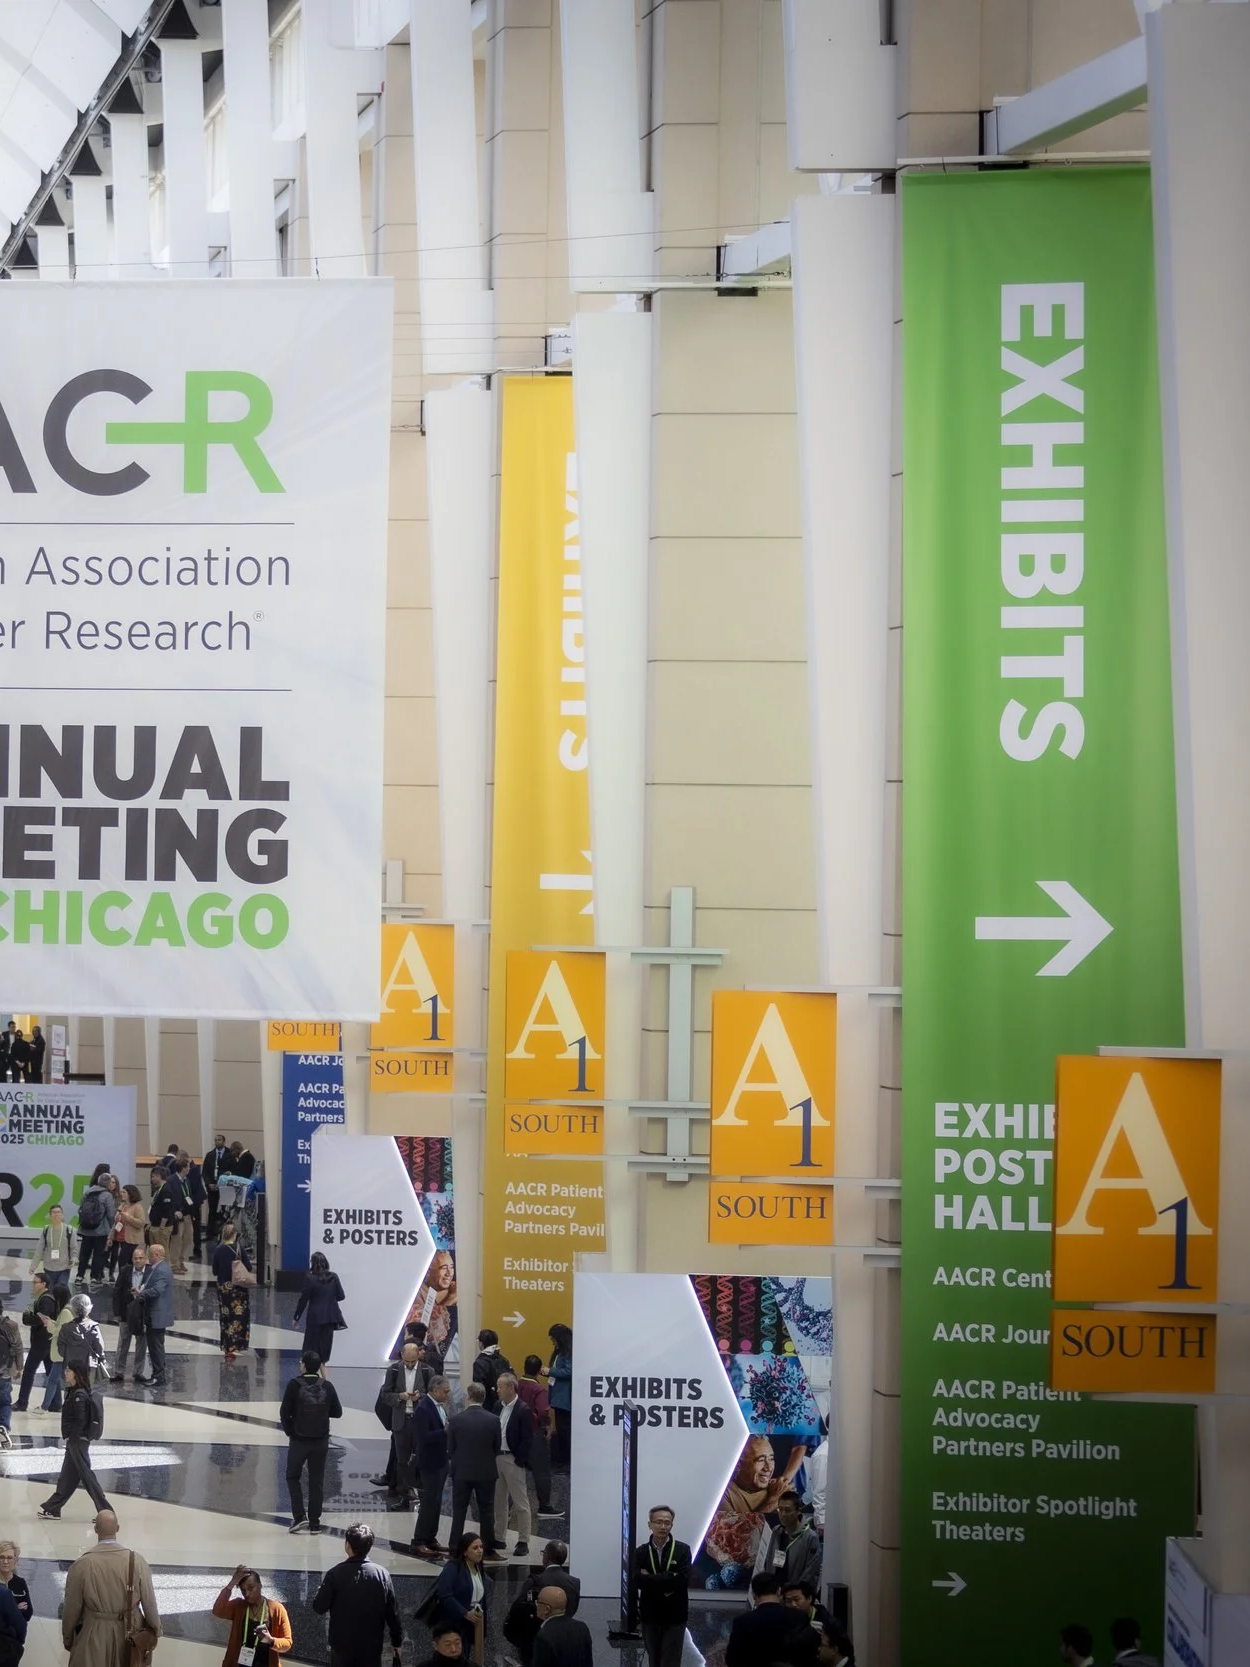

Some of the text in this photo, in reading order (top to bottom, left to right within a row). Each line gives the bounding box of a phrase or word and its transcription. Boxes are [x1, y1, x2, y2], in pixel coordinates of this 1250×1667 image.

[999, 281, 1085, 762] EXHIBITS
[25, 546, 291, 586] Association
[272, 1022, 335, 1037] SOUTH
[298, 1055, 330, 1066] AACR
[374, 1059, 449, 1077] SOUTH
[298, 1083, 330, 1094] AACR
[10, 1104, 84, 1119] ANNUAL
[298, 1111, 344, 1123] Partners
[9, 1119, 84, 1134] MEETING
[510, 1113, 599, 1135] SOUTH
[27, 1135, 84, 1145] CHICAGO
[505, 1182, 604, 1198] AACR Patient
[323, 1208, 403, 1226] EXHIBITS
[505, 1200, 576, 1219] Advocacy
[717, 1196, 827, 1220] SOUTH
[935, 1194, 1052, 1232] HALL
[322, 1228, 418, 1246] & POSTERS
[504, 1220, 566, 1235] Partners
[503, 1257, 568, 1273] Exhibitor
[503, 1276, 565, 1292] Theaters
[933, 1266, 996, 1287] AACR
[932, 1323, 996, 1343] AACR
[1061, 1324, 1208, 1359] SOUTH
[590, 1376, 703, 1401] EXHIBITS
[932, 1379, 996, 1400] AACR
[589, 1403, 606, 1427] &
[932, 1407, 1041, 1432] Advocacy
[932, 1435, 1121, 1461] Partners Pavilion
[932, 1491, 1138, 1520] Exhibitor Spotlight
[932, 1519, 1025, 1542] Theaters
